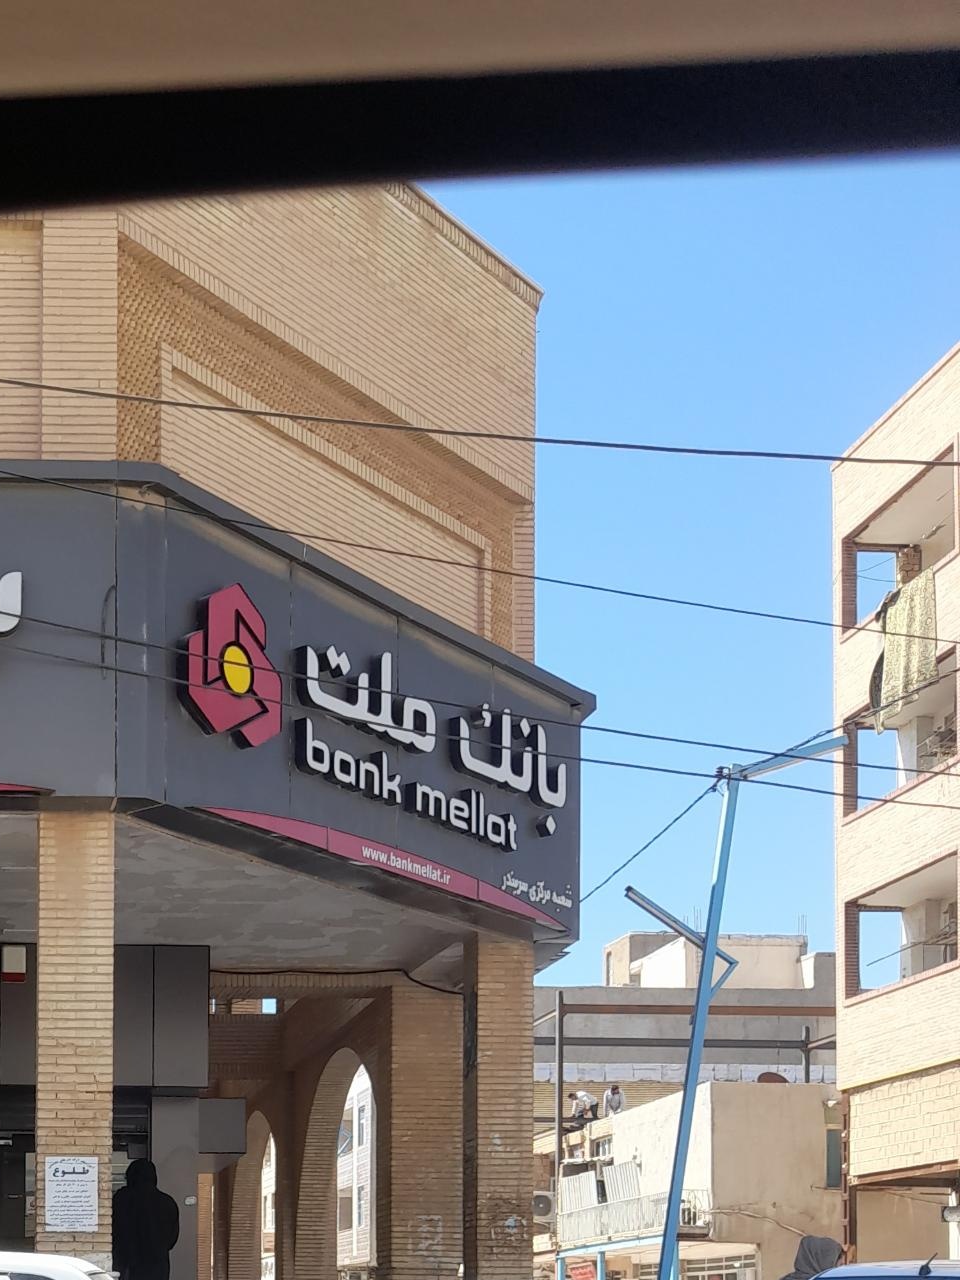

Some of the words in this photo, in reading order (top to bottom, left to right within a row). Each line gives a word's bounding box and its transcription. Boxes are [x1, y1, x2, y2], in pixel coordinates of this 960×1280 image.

[305, 645, 437, 753] ملت
[306, 717, 402, 804] bank
[415, 781, 518, 851] mellat
[361, 845, 451, 886] www.bankmellat.ir
